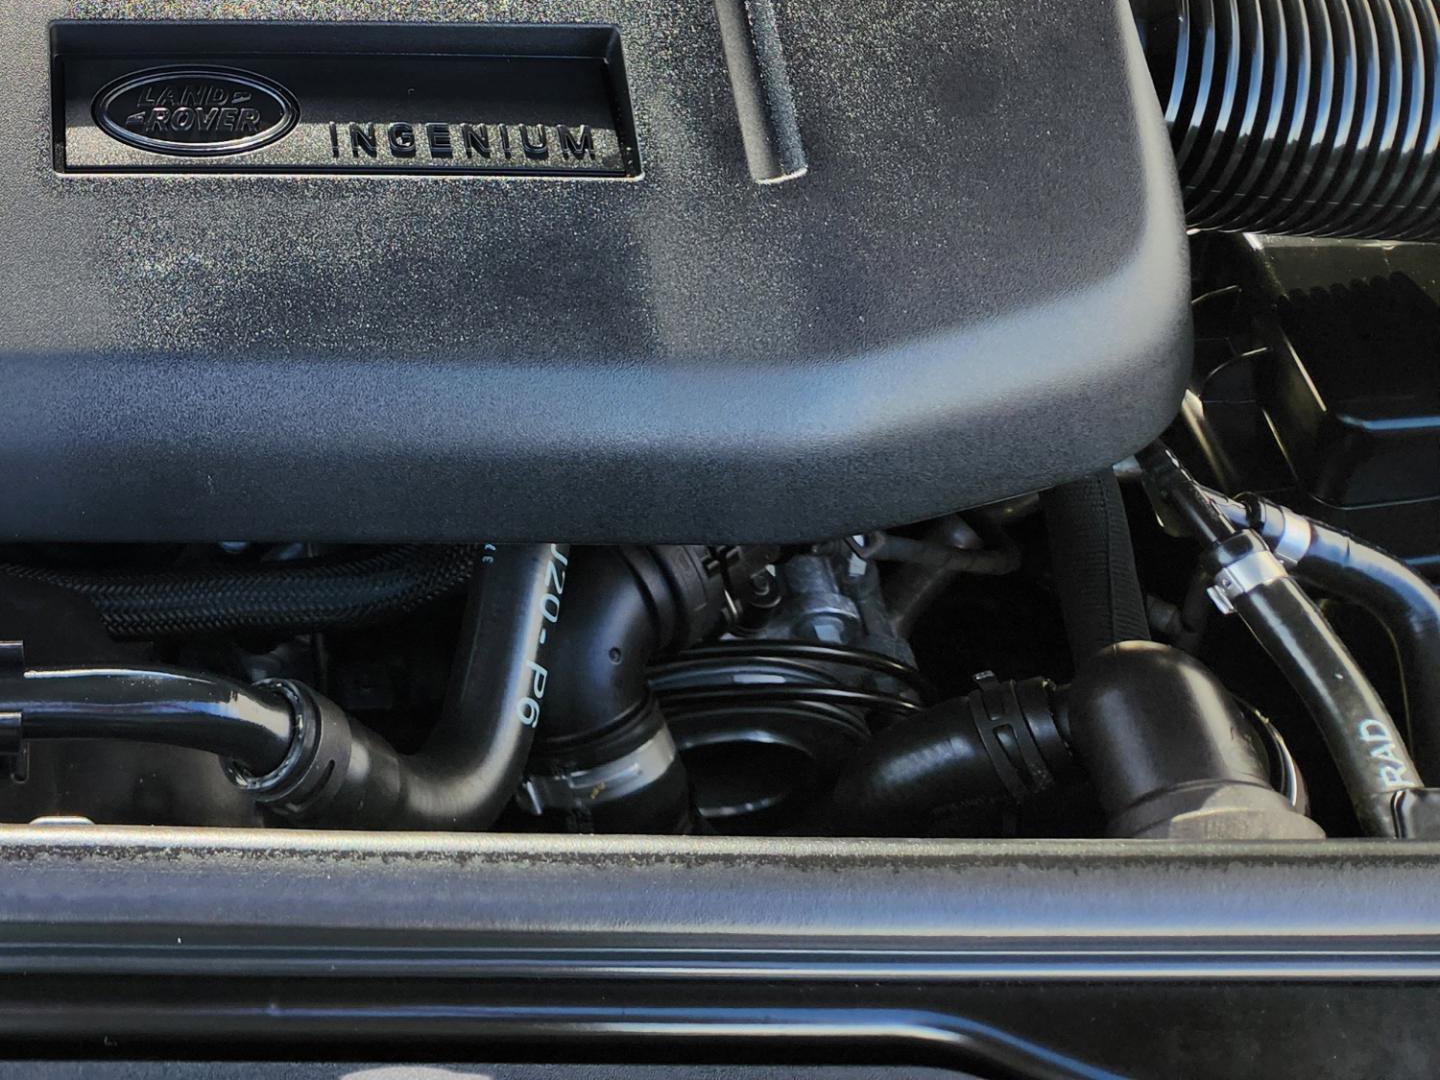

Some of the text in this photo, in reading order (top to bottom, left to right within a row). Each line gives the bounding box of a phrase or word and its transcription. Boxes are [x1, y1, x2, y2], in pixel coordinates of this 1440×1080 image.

[137, 85, 229, 108] LAND
[145, 106, 262, 133] ROVER
[329, 121, 596, 159] INGENIUM
[1360, 718, 1417, 788] RAD
